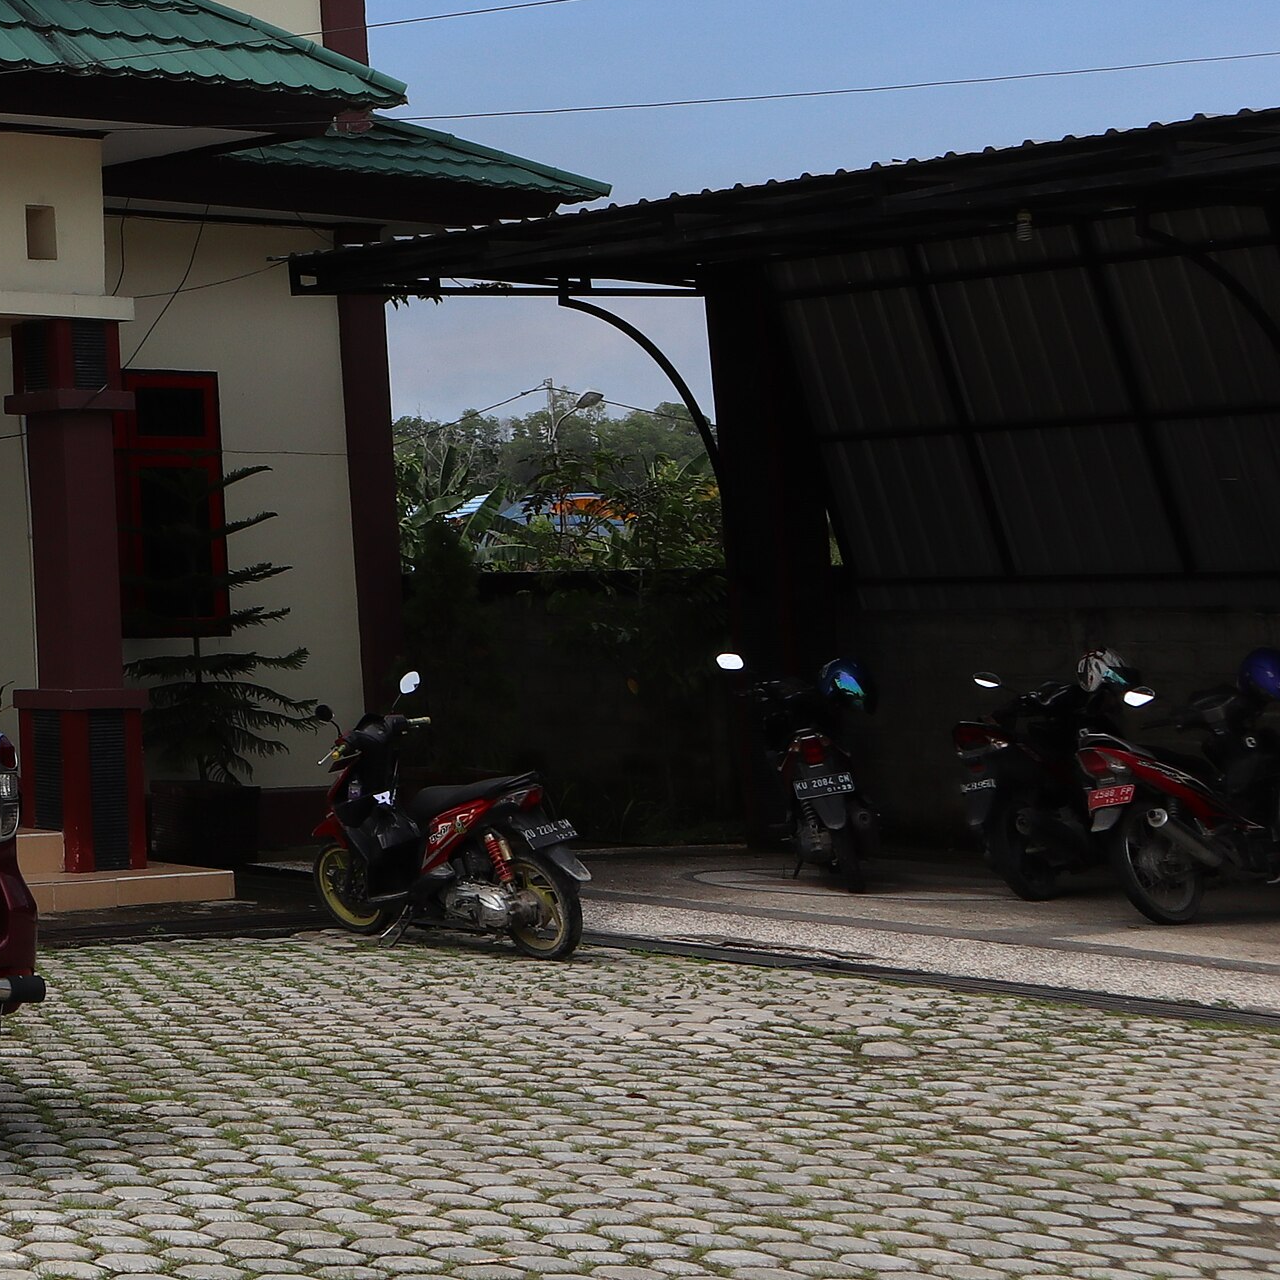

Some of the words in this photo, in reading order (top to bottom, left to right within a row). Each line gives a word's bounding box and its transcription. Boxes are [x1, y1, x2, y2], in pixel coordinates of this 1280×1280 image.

[796, 781, 808, 791] KU
[811, 777, 834, 788] 2084
[536, 823, 558, 835] 2204
